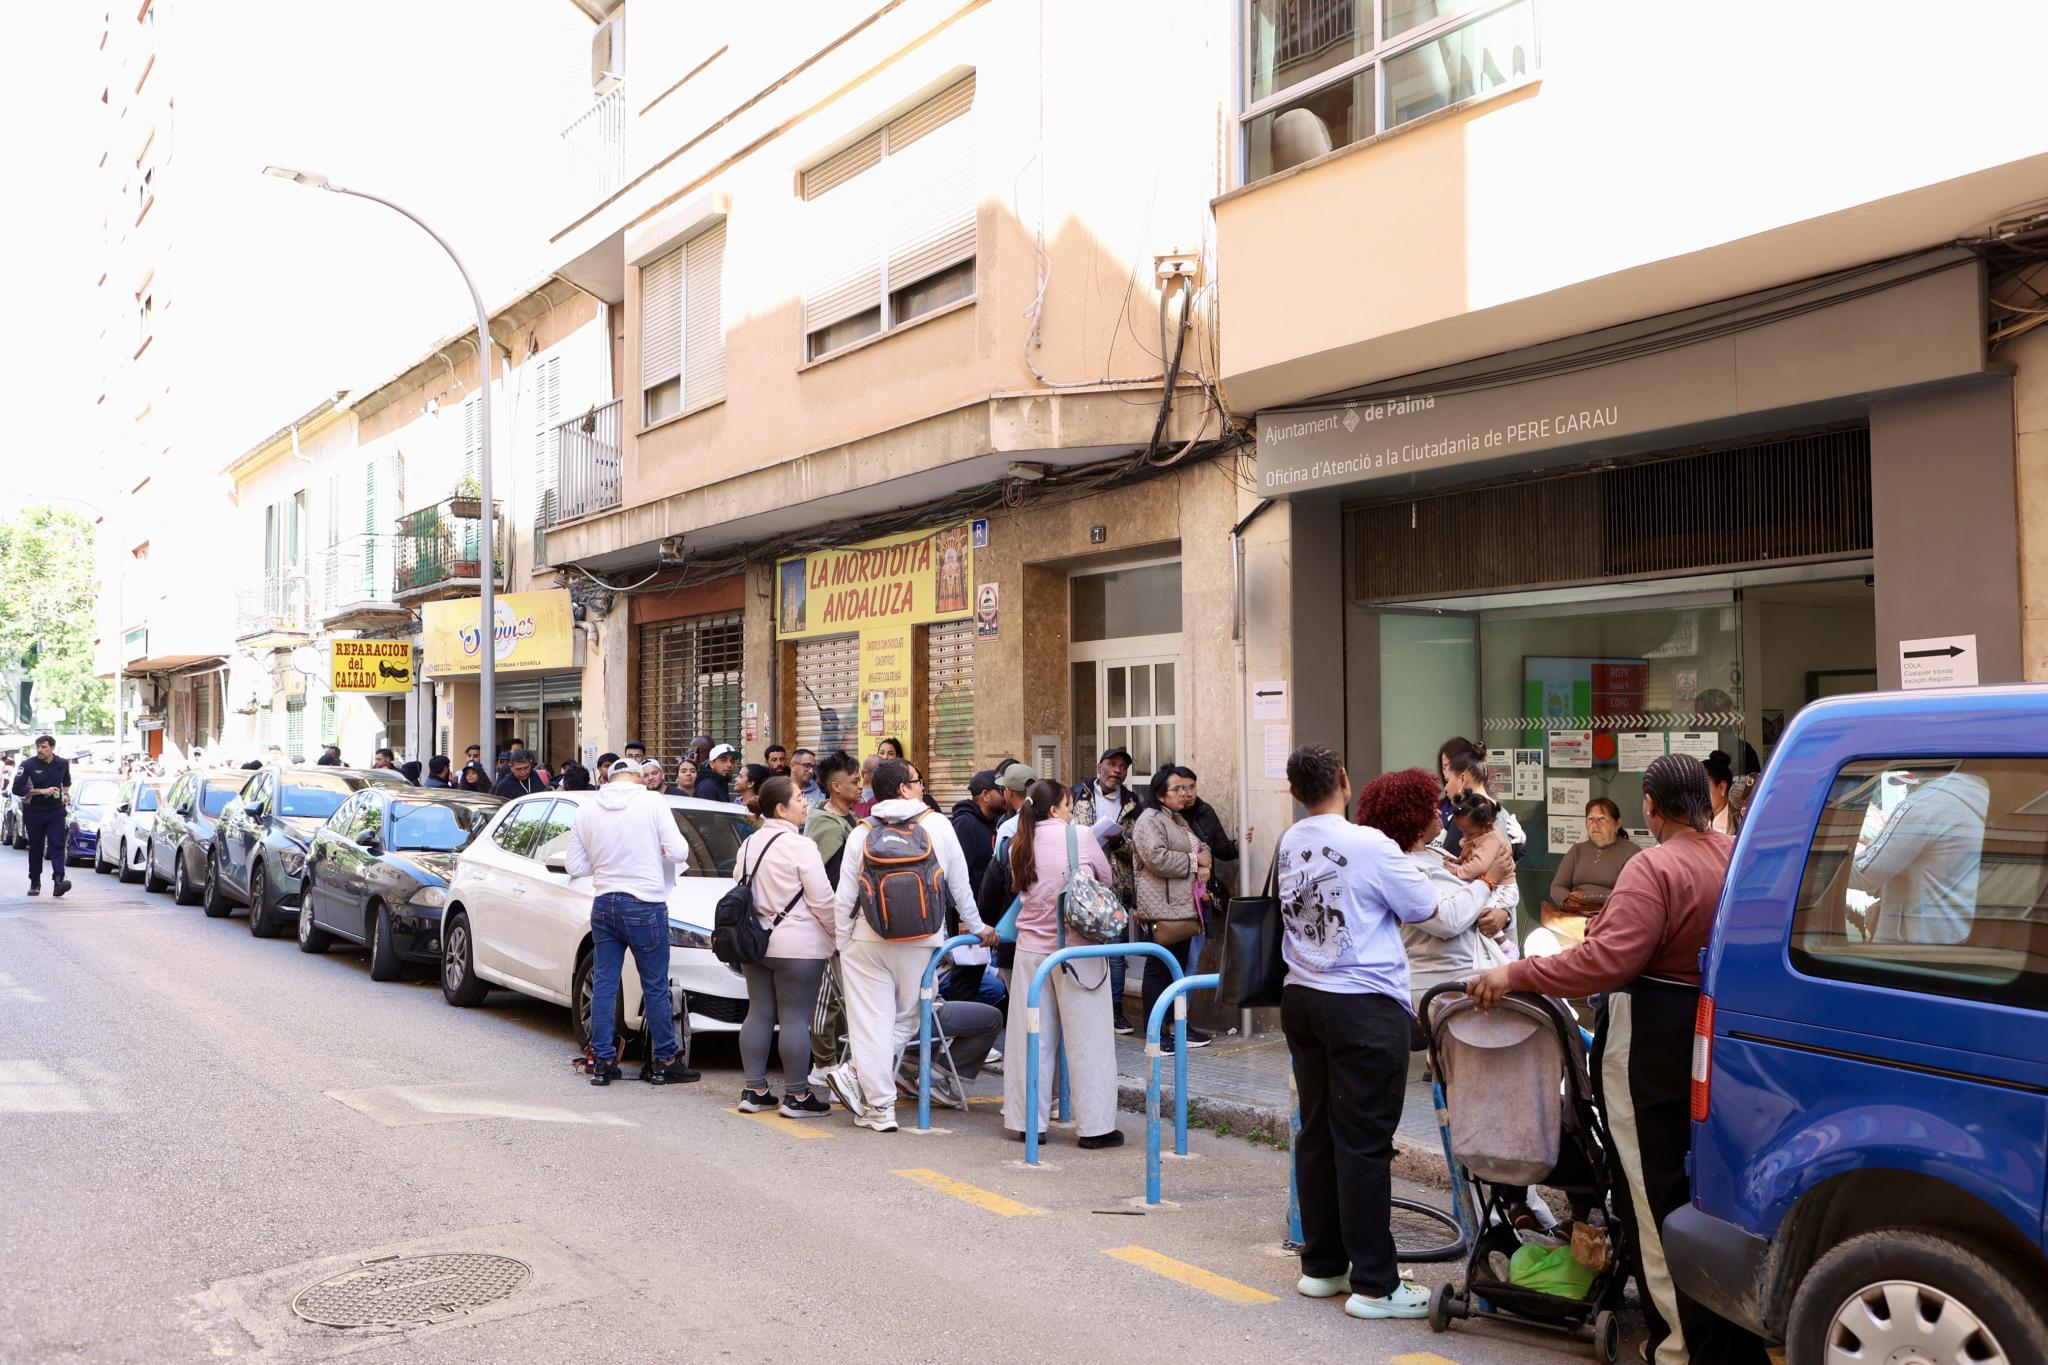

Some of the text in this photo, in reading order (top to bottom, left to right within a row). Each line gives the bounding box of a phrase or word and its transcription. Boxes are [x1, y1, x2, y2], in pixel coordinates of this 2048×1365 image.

[1265, 395, 1435, 445] Ajuntament de Palma
[1265, 405, 1619, 488] Oficina d'Atenció a la Ciutadania de PERE GARAU
[976, 524, 983, 539] R
[809, 538, 931, 590] LA MORDIDITA
[822, 580, 913, 625] ANDALUZA
[335, 642, 408, 656] REPARACION
[348, 657, 363, 670] del
[335, 671, 376, 689] CALZADO
